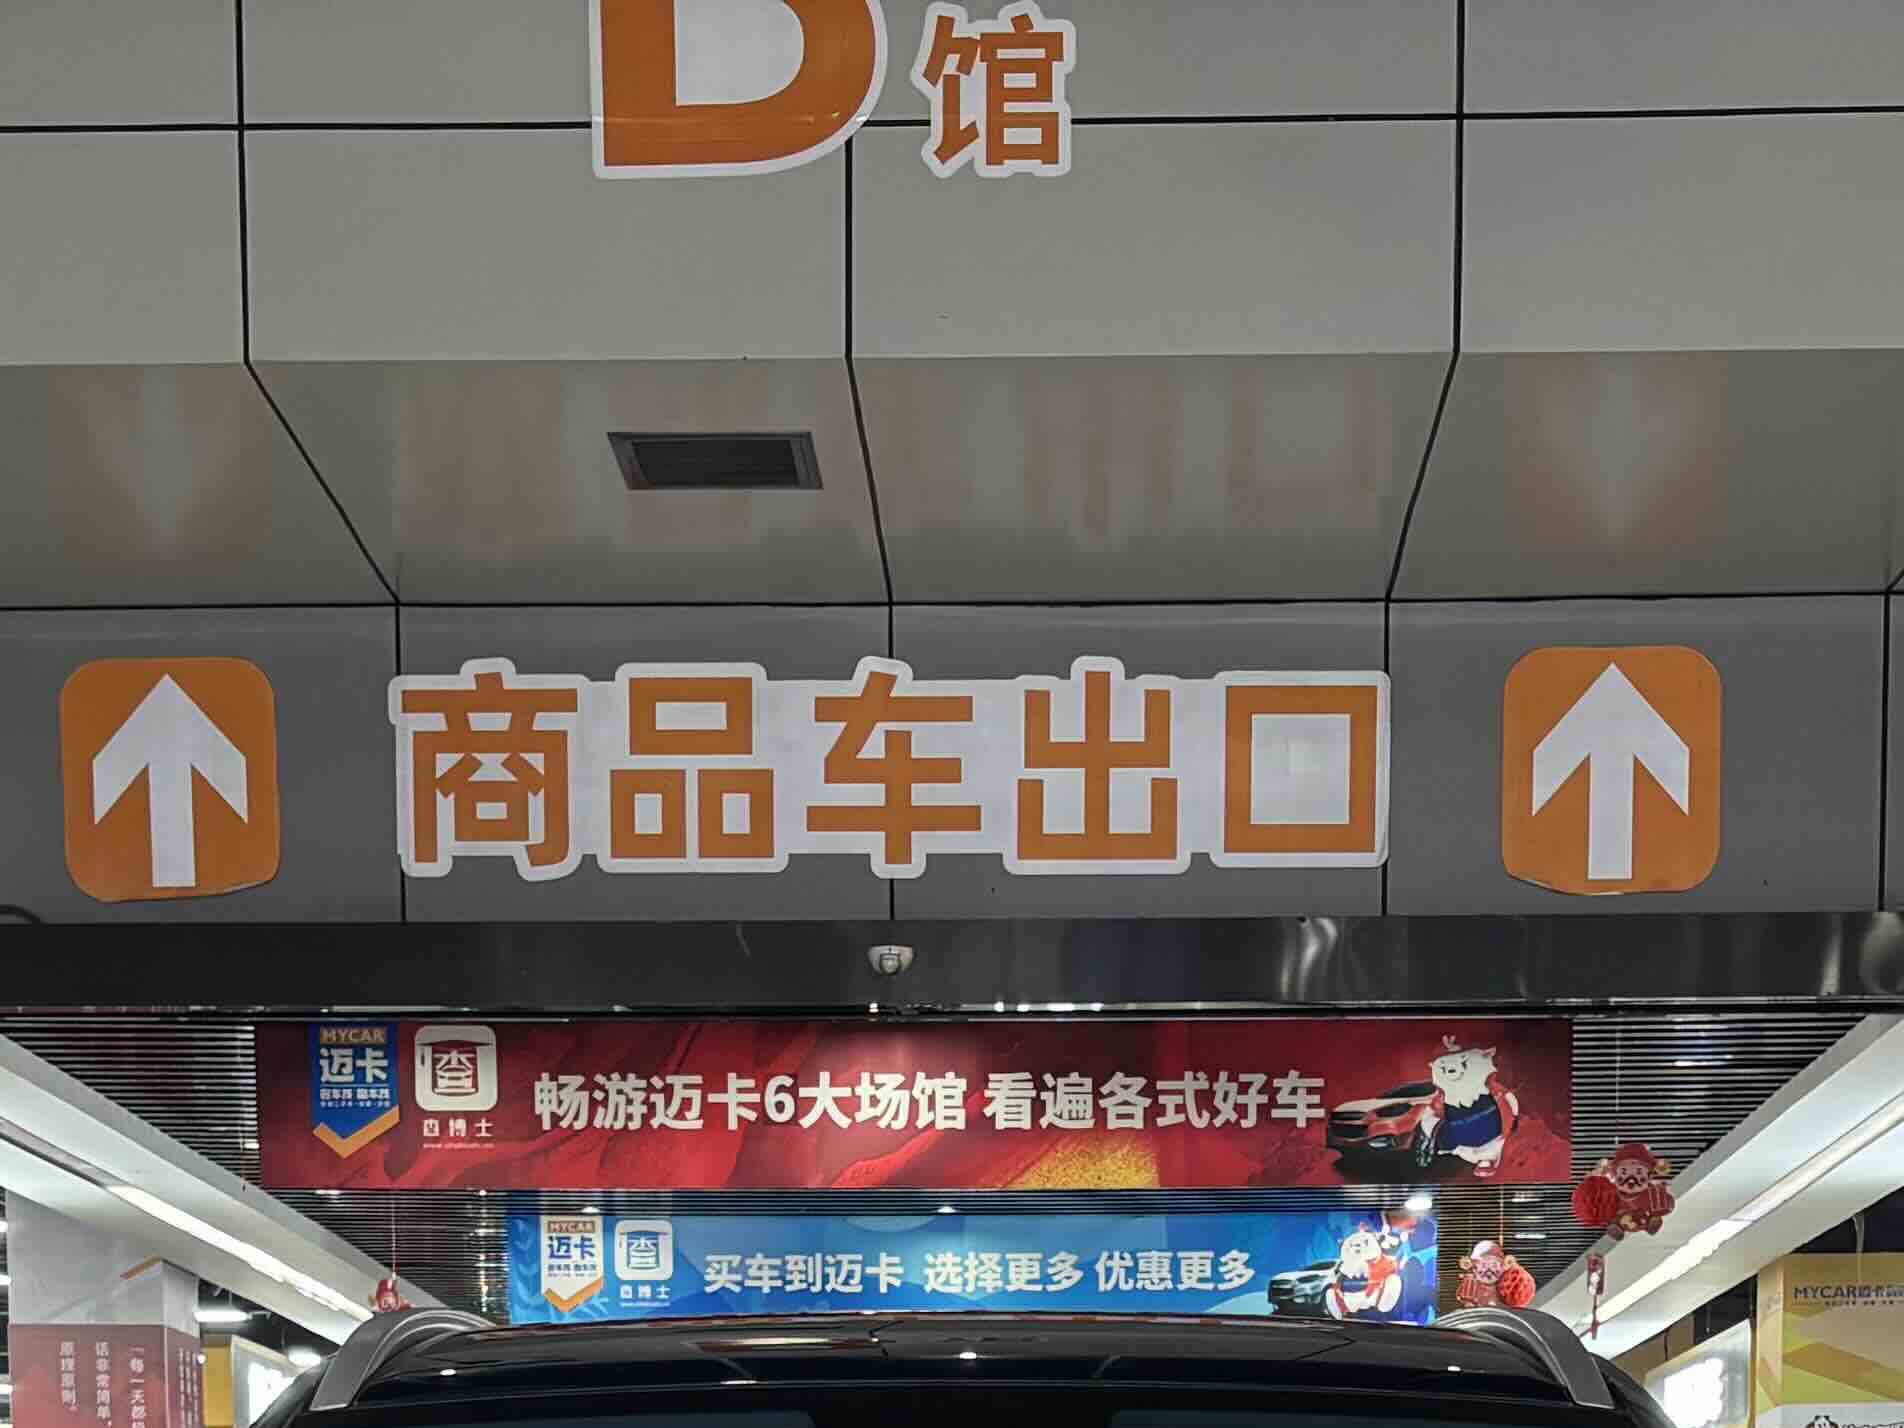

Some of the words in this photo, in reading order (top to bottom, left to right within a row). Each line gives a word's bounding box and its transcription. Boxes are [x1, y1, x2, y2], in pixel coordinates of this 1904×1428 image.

[922, 14, 1064, 166] 馆
[399, 670, 1379, 868] 商品车出口
[322, 1029, 386, 1044] MYCAR
[320, 1047, 389, 1084] 迈卡
[533, 1072, 968, 1131] 畅游迈卡6大场馆
[983, 1070, 1326, 1130] 看遍各式好车
[547, 1235, 596, 1260] 迈卡
[703, 1252, 904, 1294] 买车到迈卡
[922, 1251, 1085, 1292] 选择更多
[1094, 1250, 1257, 1291] 优惠更多
